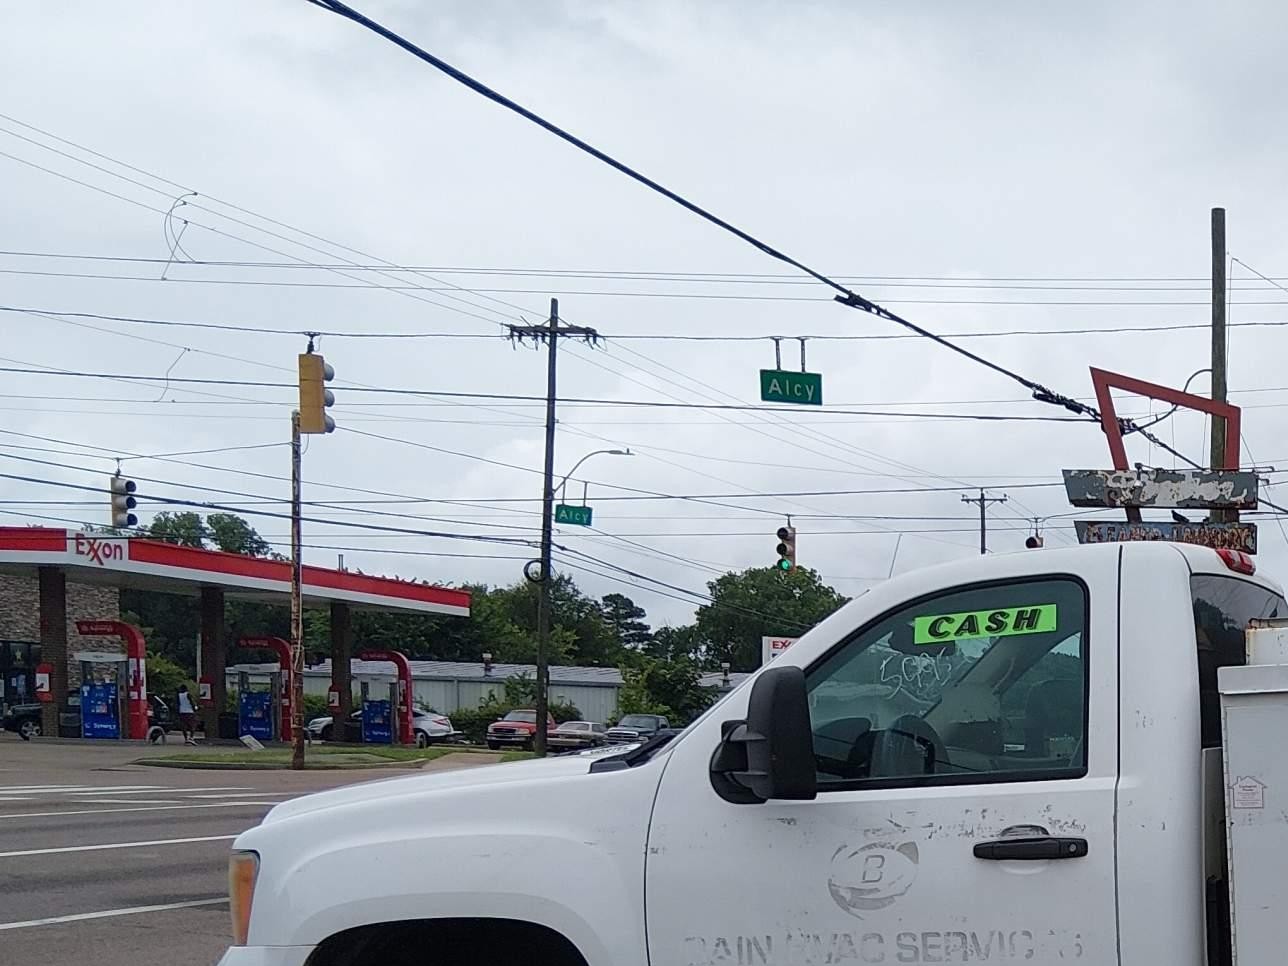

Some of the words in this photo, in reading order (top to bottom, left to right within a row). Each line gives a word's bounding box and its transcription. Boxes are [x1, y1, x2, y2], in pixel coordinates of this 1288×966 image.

[768, 378, 815, 402] Alcy
[559, 509, 589, 524] Alcy
[75, 532, 123, 566] Exxon
[928, 608, 1043, 639] CASH
